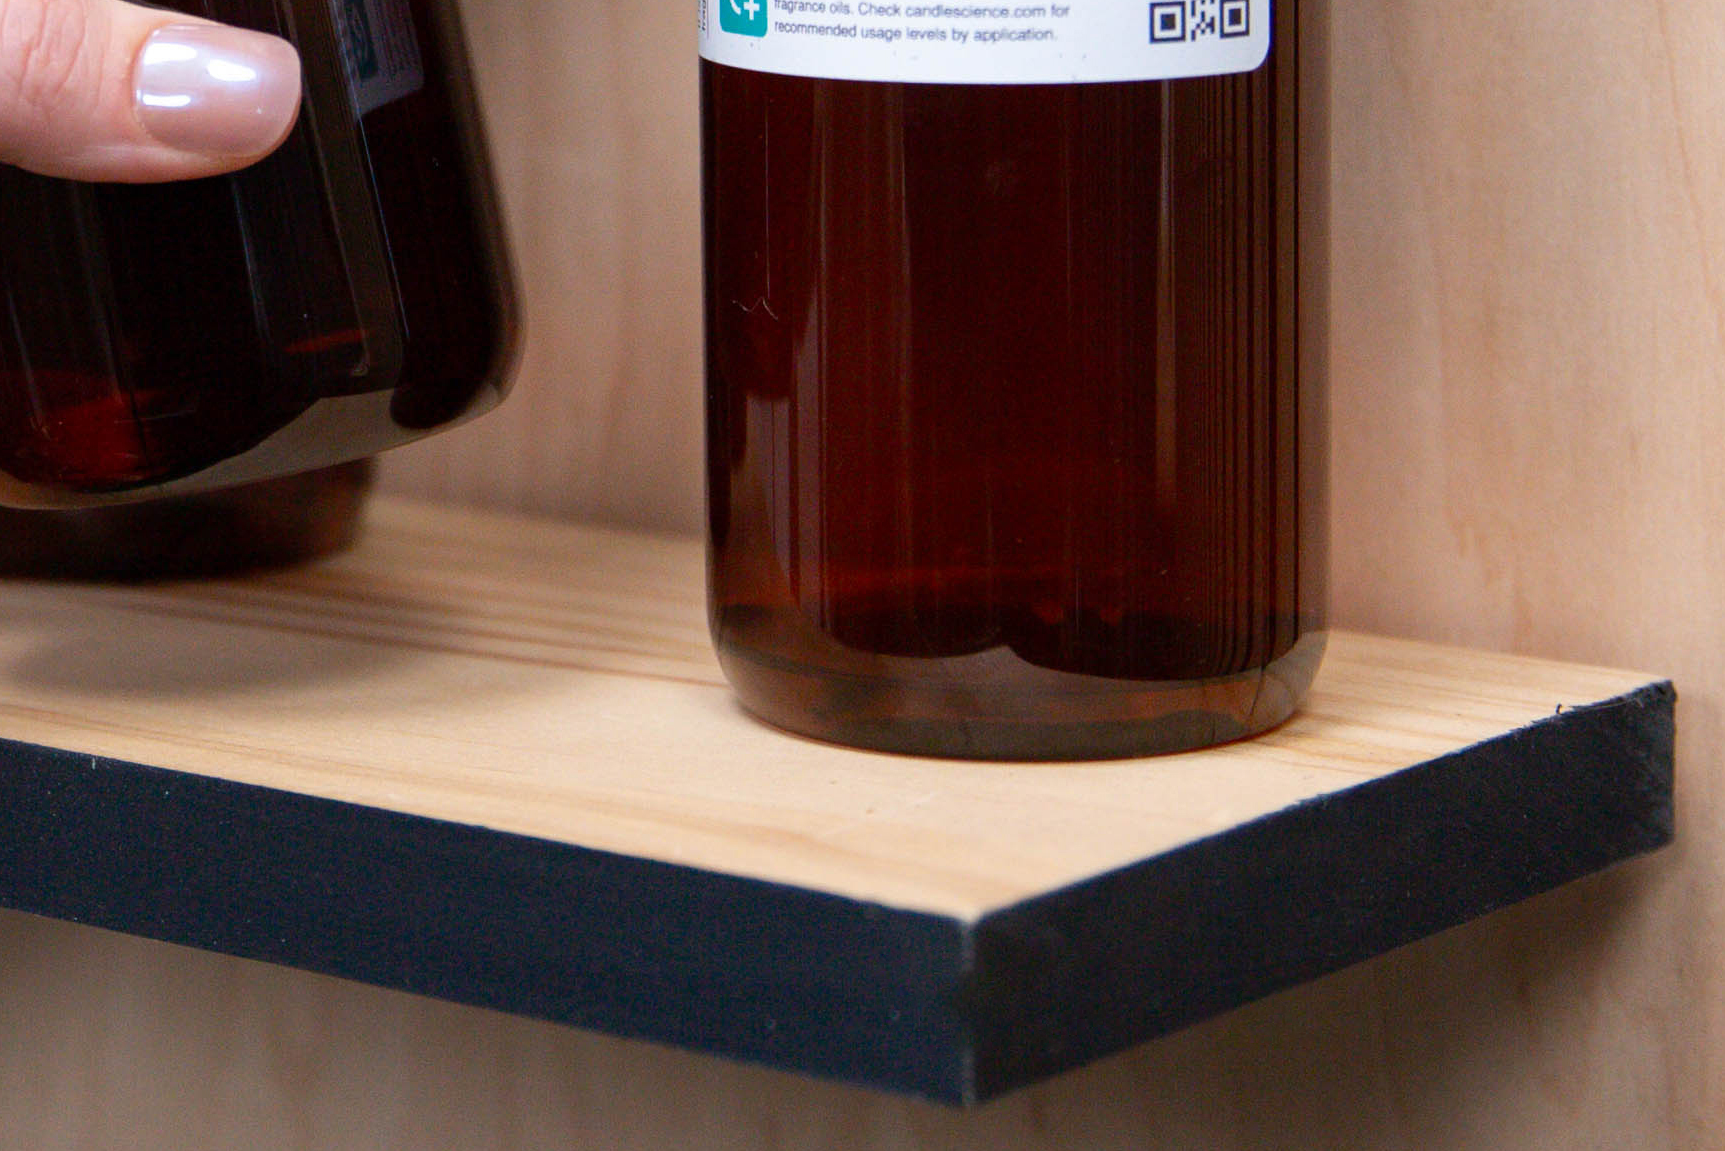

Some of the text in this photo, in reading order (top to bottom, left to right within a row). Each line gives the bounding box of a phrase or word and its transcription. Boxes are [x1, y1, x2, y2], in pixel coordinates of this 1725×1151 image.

[829, 1, 854, 16] oils.
[858, 2, 901, 17] Check
[905, 4, 1046, 19] candlescience.com
[1051, 3, 1070, 18] for
[774, 20, 1058, 44] recommended usage levels by application.
